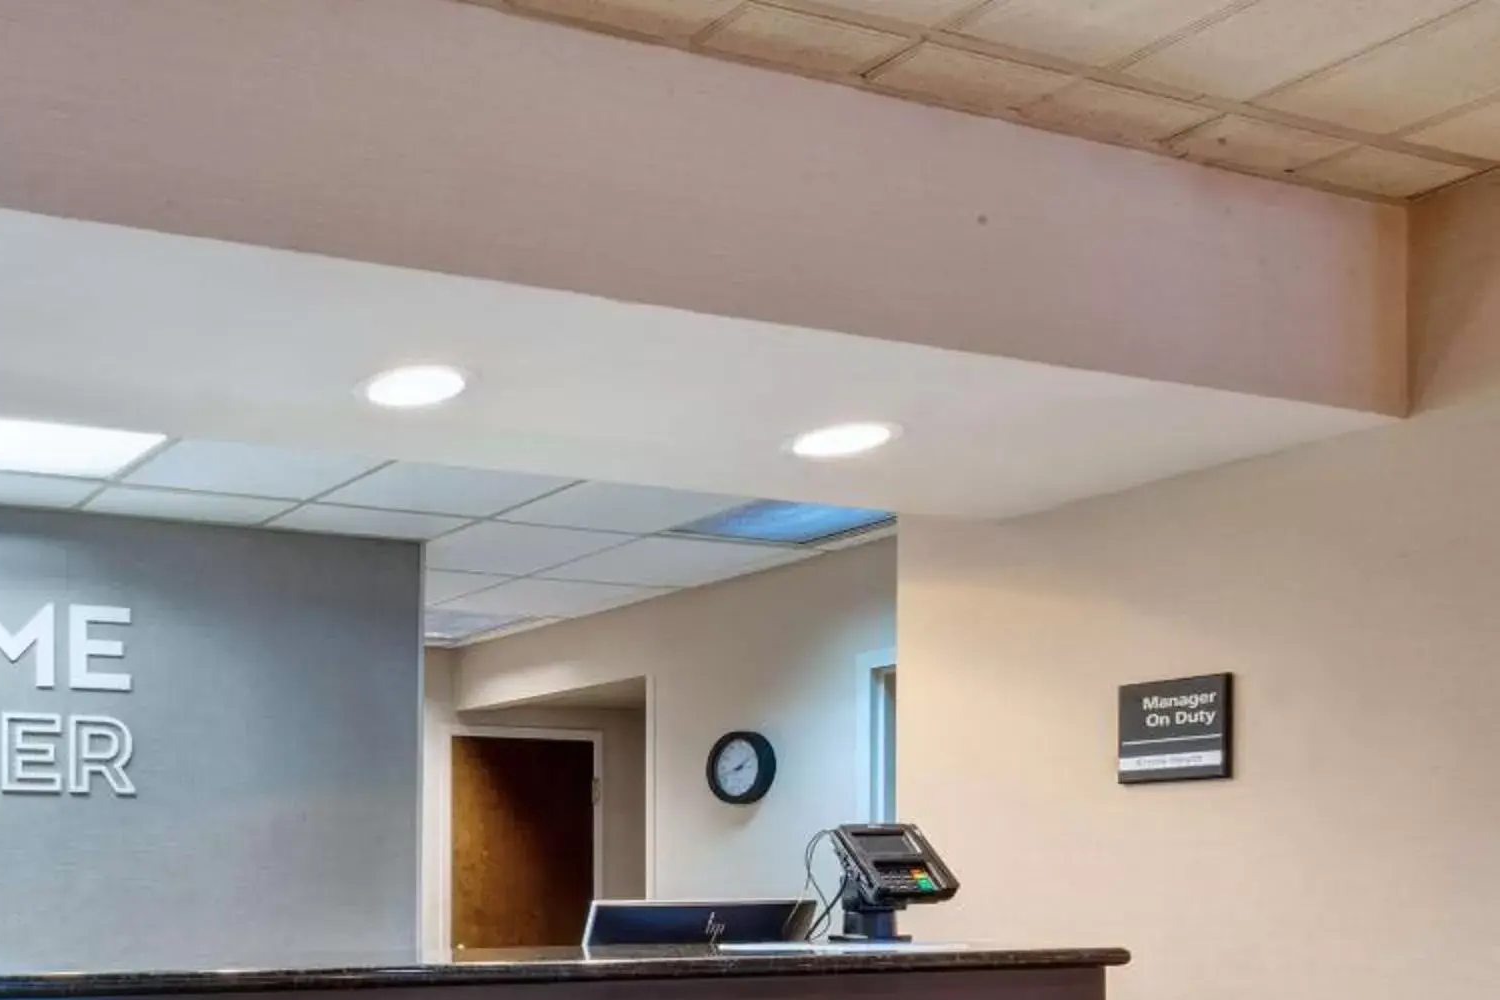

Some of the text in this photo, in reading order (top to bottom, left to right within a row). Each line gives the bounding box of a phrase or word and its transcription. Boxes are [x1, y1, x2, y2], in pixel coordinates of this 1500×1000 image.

[1142, 691, 1217, 710] Manager
[1145, 711, 1216, 727] On Duty
